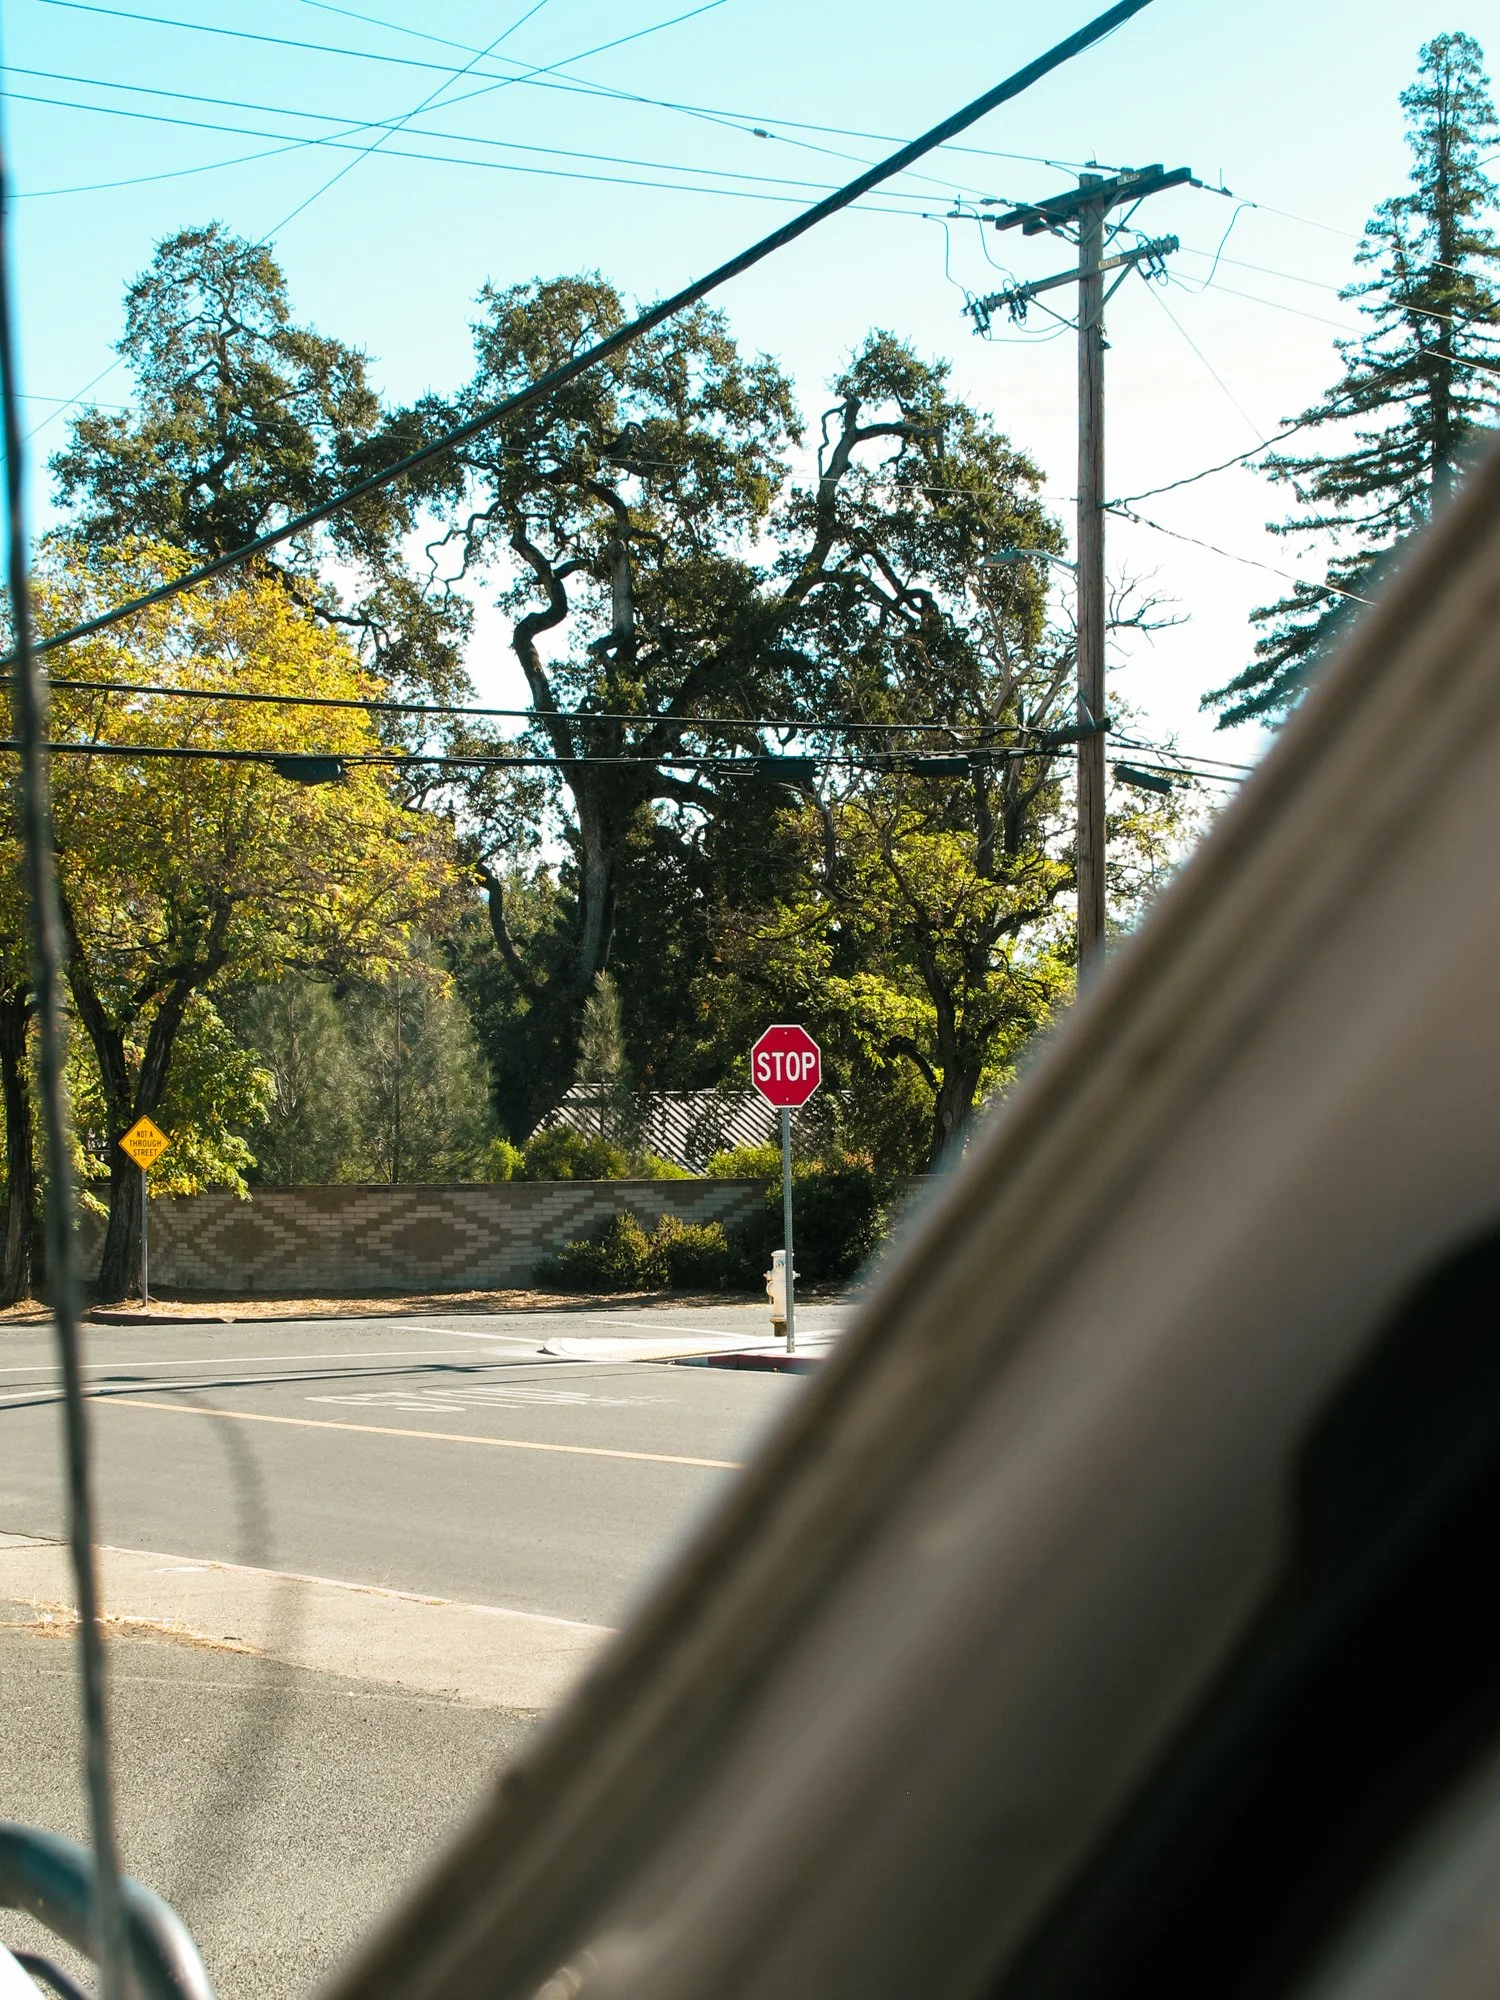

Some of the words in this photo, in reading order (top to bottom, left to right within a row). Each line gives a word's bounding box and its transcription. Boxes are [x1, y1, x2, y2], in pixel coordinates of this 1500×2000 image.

[757, 1051, 816, 1082] STOP
[136, 1130, 147, 1138] NOT
[149, 1130, 154, 1138] A
[129, 1139, 162, 1147] THROUGH
[132, 1148, 157, 1157] STREET
[304, 1387, 626, 1413] STOP
